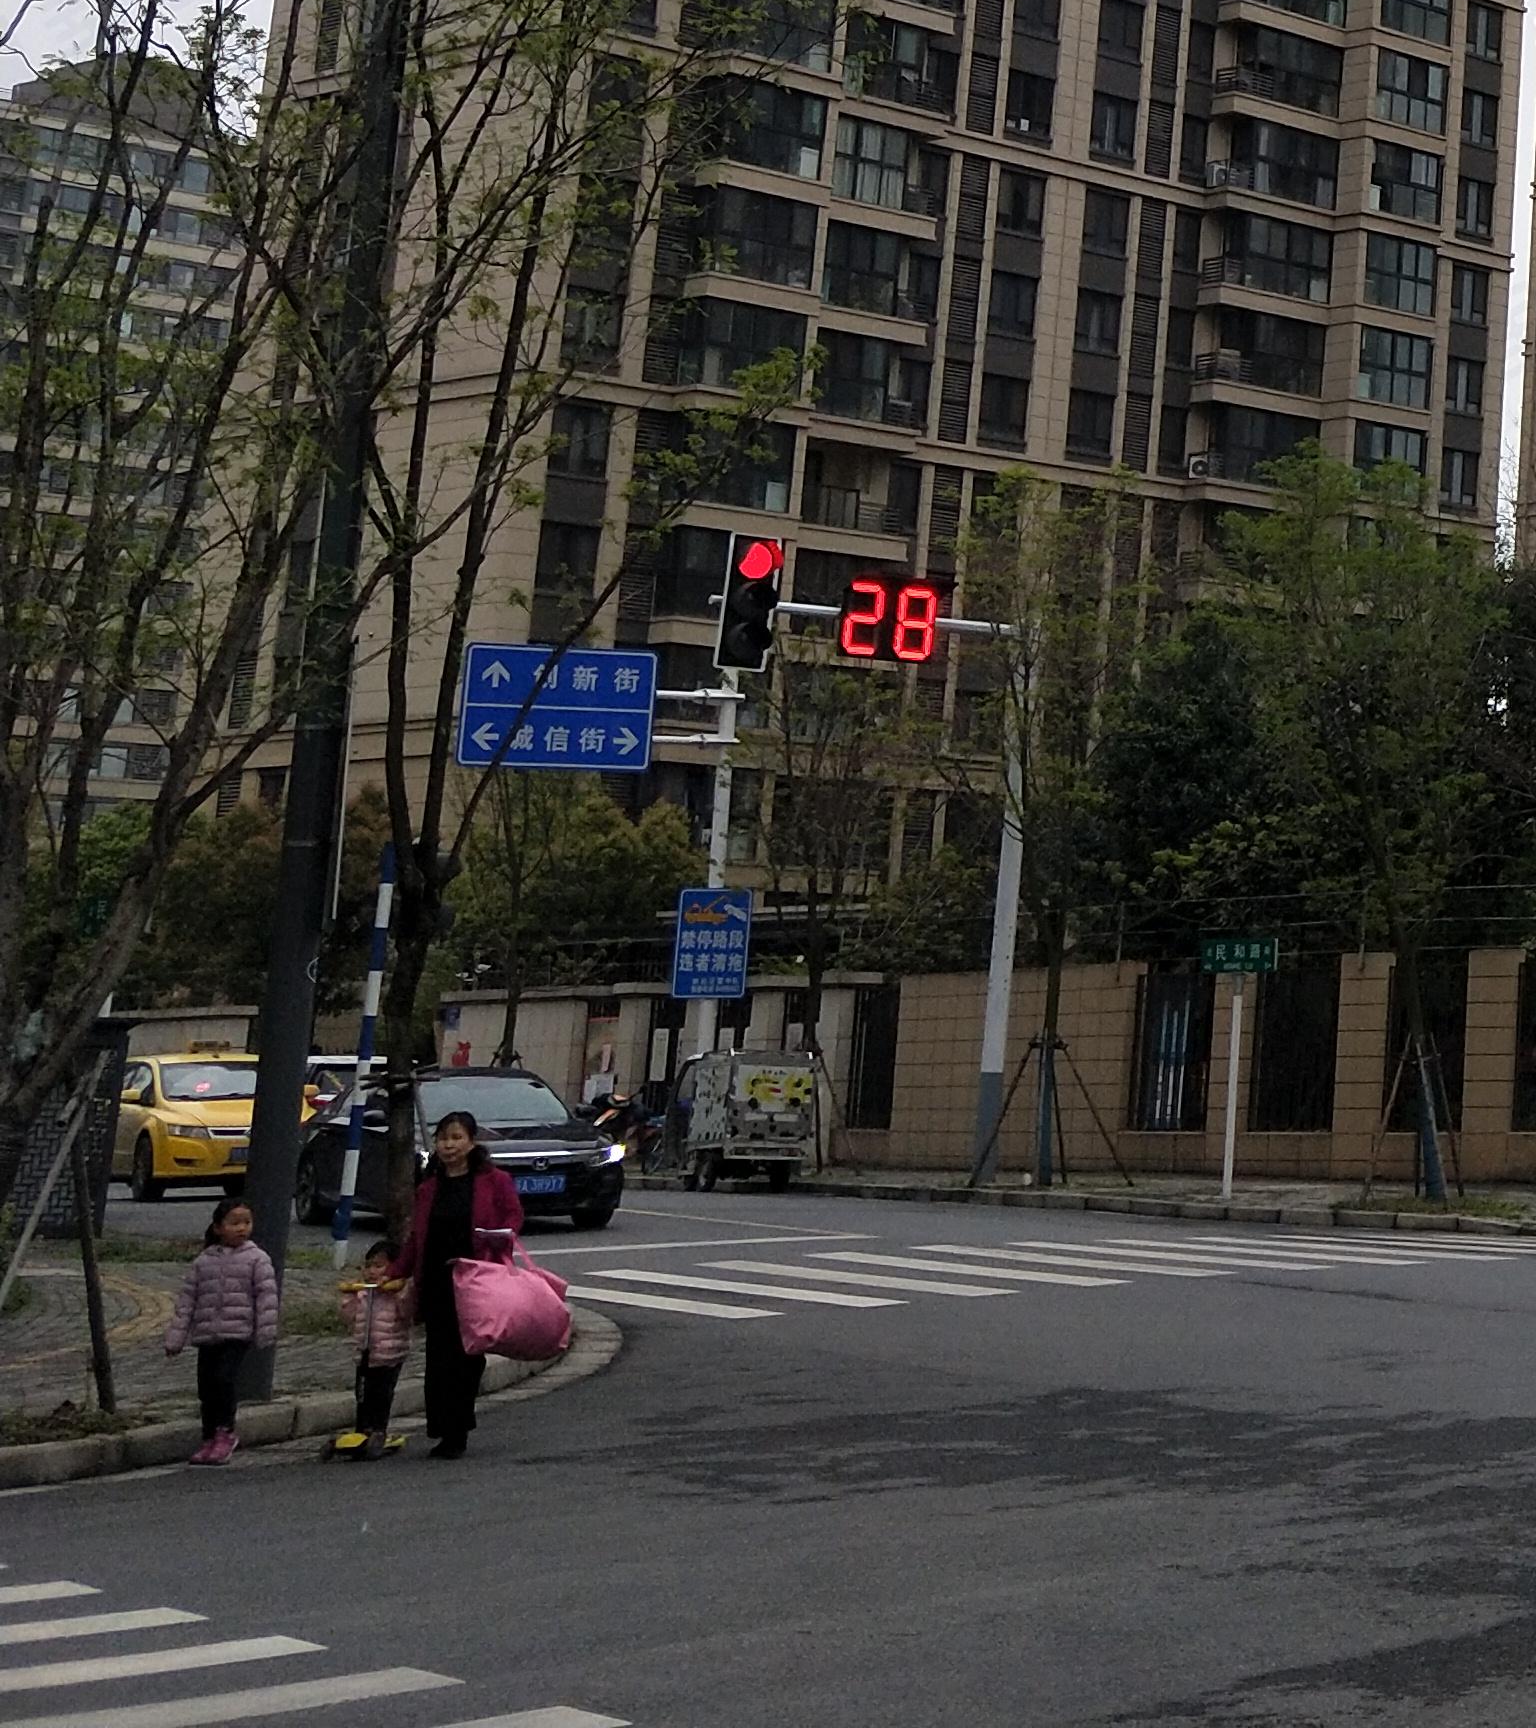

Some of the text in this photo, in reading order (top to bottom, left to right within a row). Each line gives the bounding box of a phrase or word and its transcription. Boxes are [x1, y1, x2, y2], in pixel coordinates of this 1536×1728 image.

[842, 580, 936, 660] 28
[680, 930, 744, 950] 禁停路段
